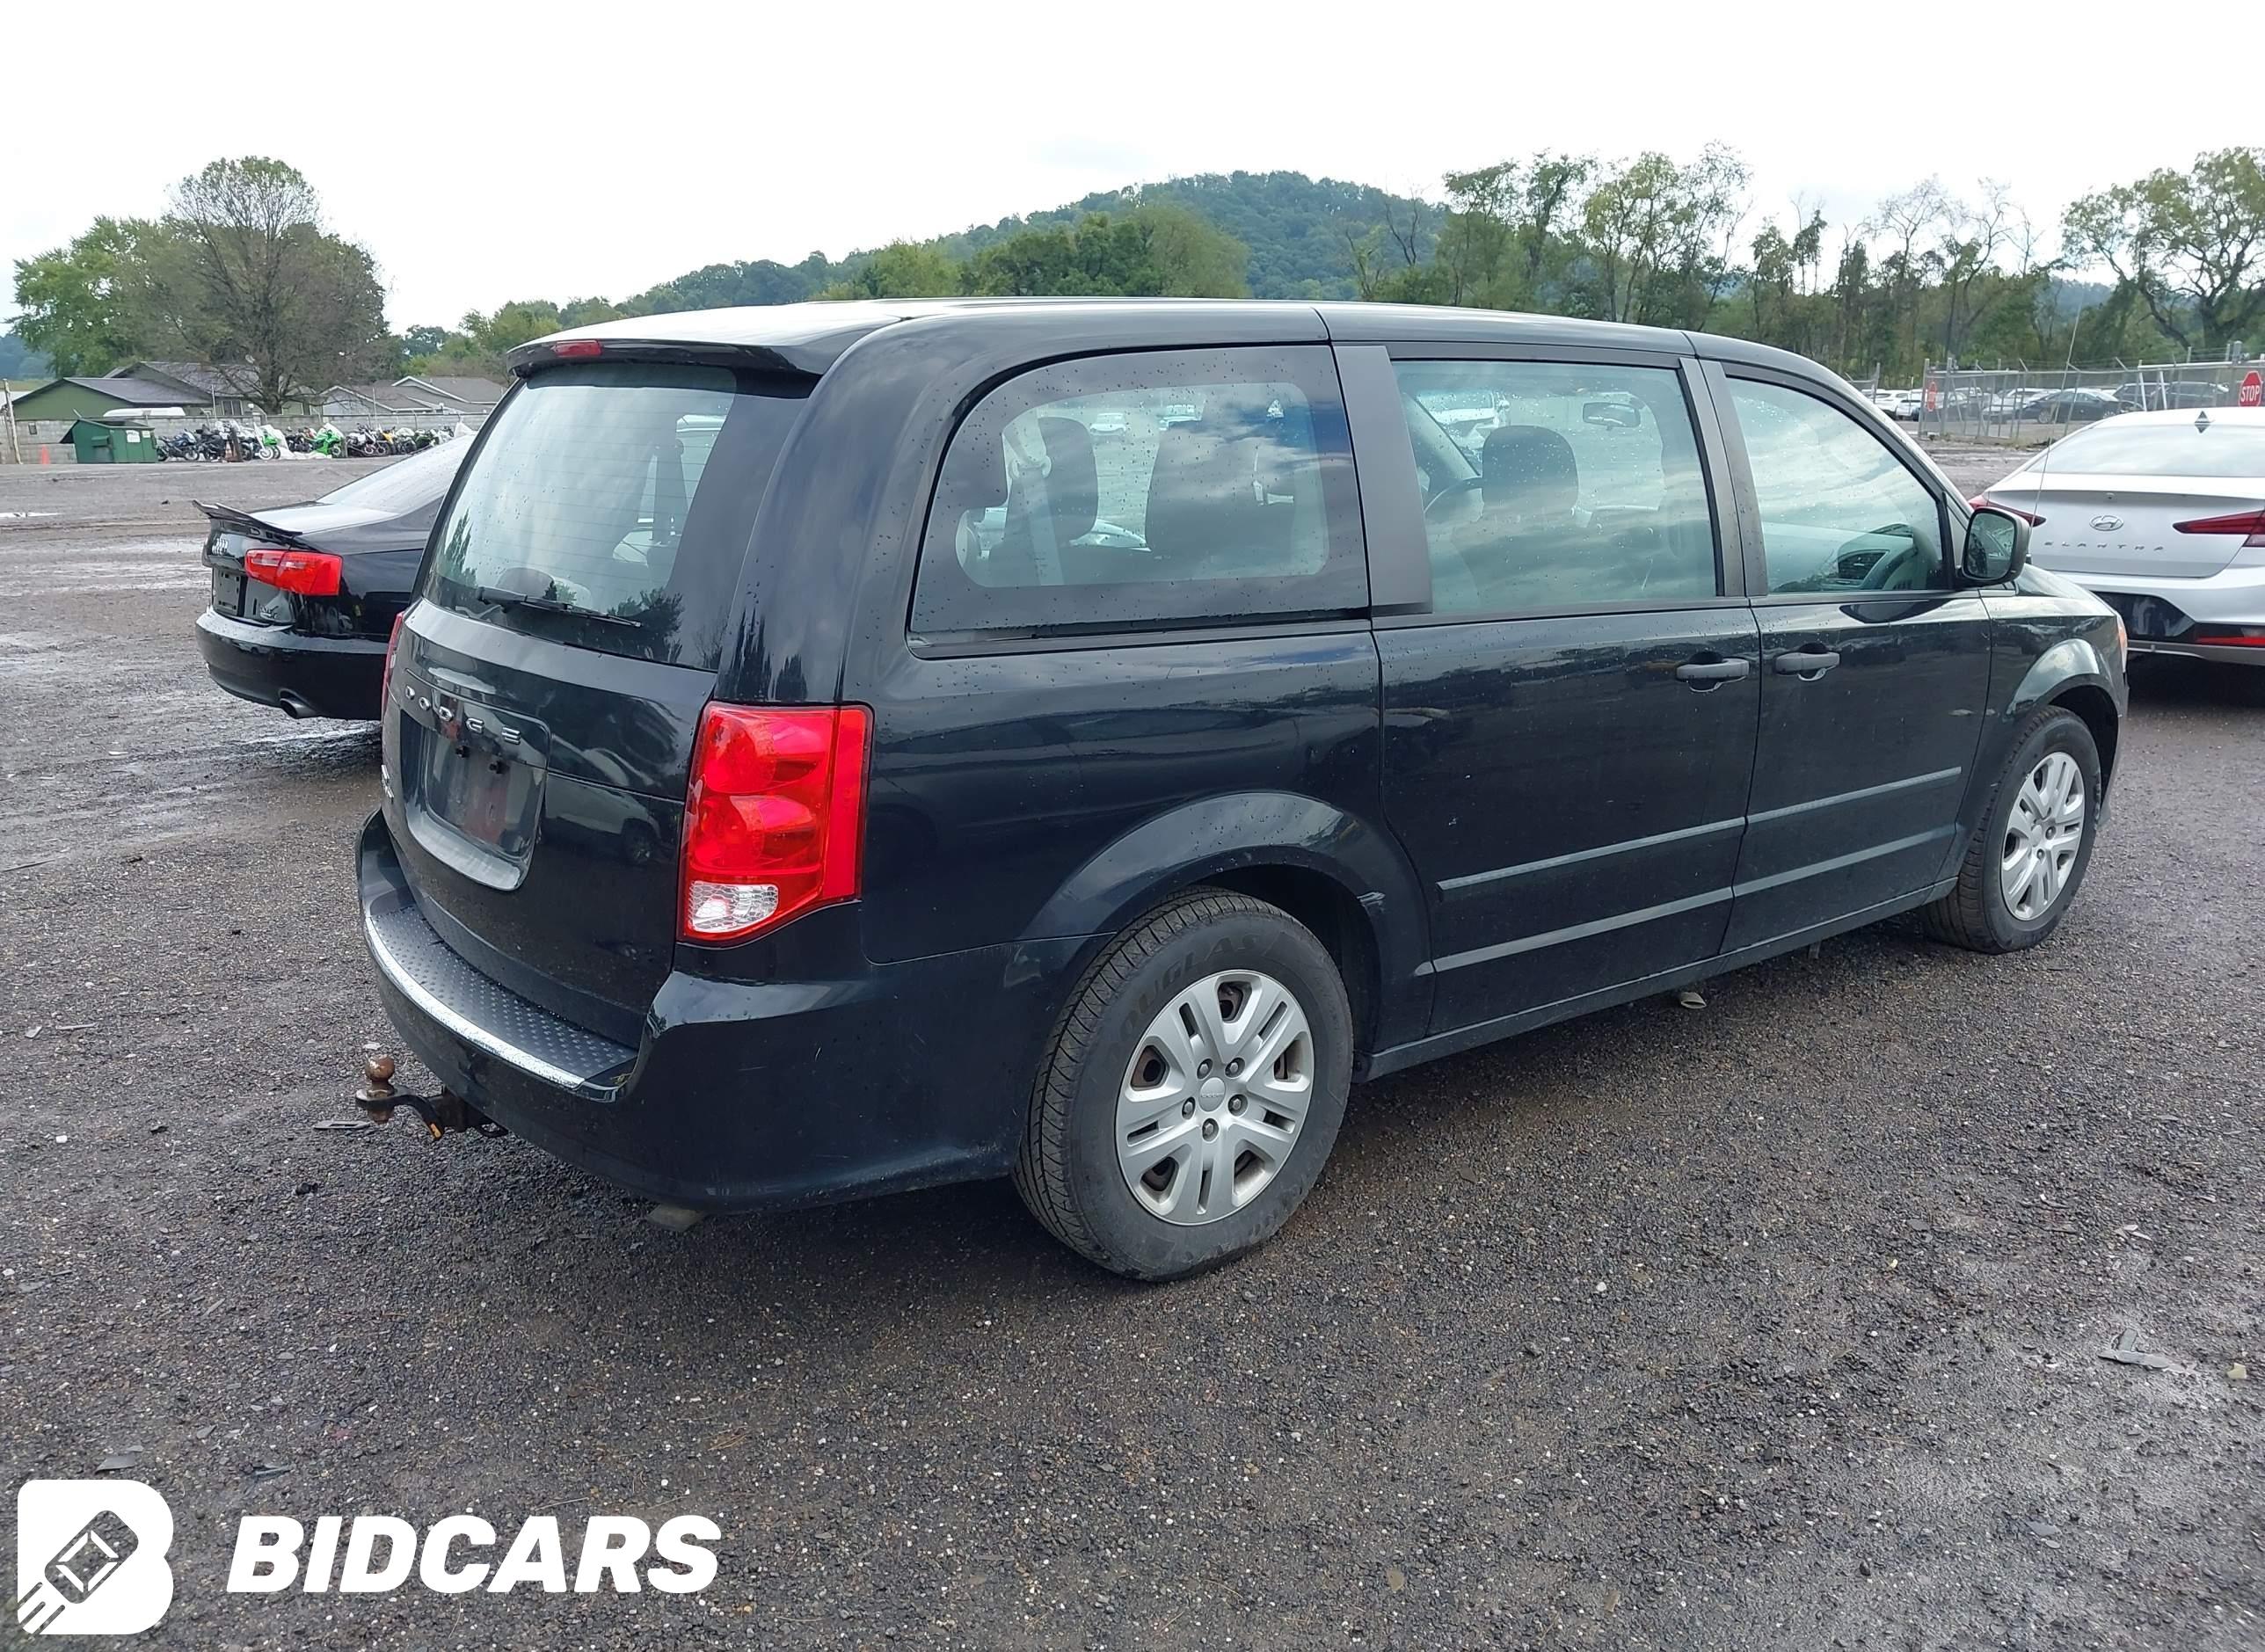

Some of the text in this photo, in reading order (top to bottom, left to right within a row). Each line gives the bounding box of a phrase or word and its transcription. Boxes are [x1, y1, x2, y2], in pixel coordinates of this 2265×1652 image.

[2241, 385, 2261, 402] STOP
[2043, 541, 2164, 551] ELANTRA
[405, 686, 521, 745] DODGE
